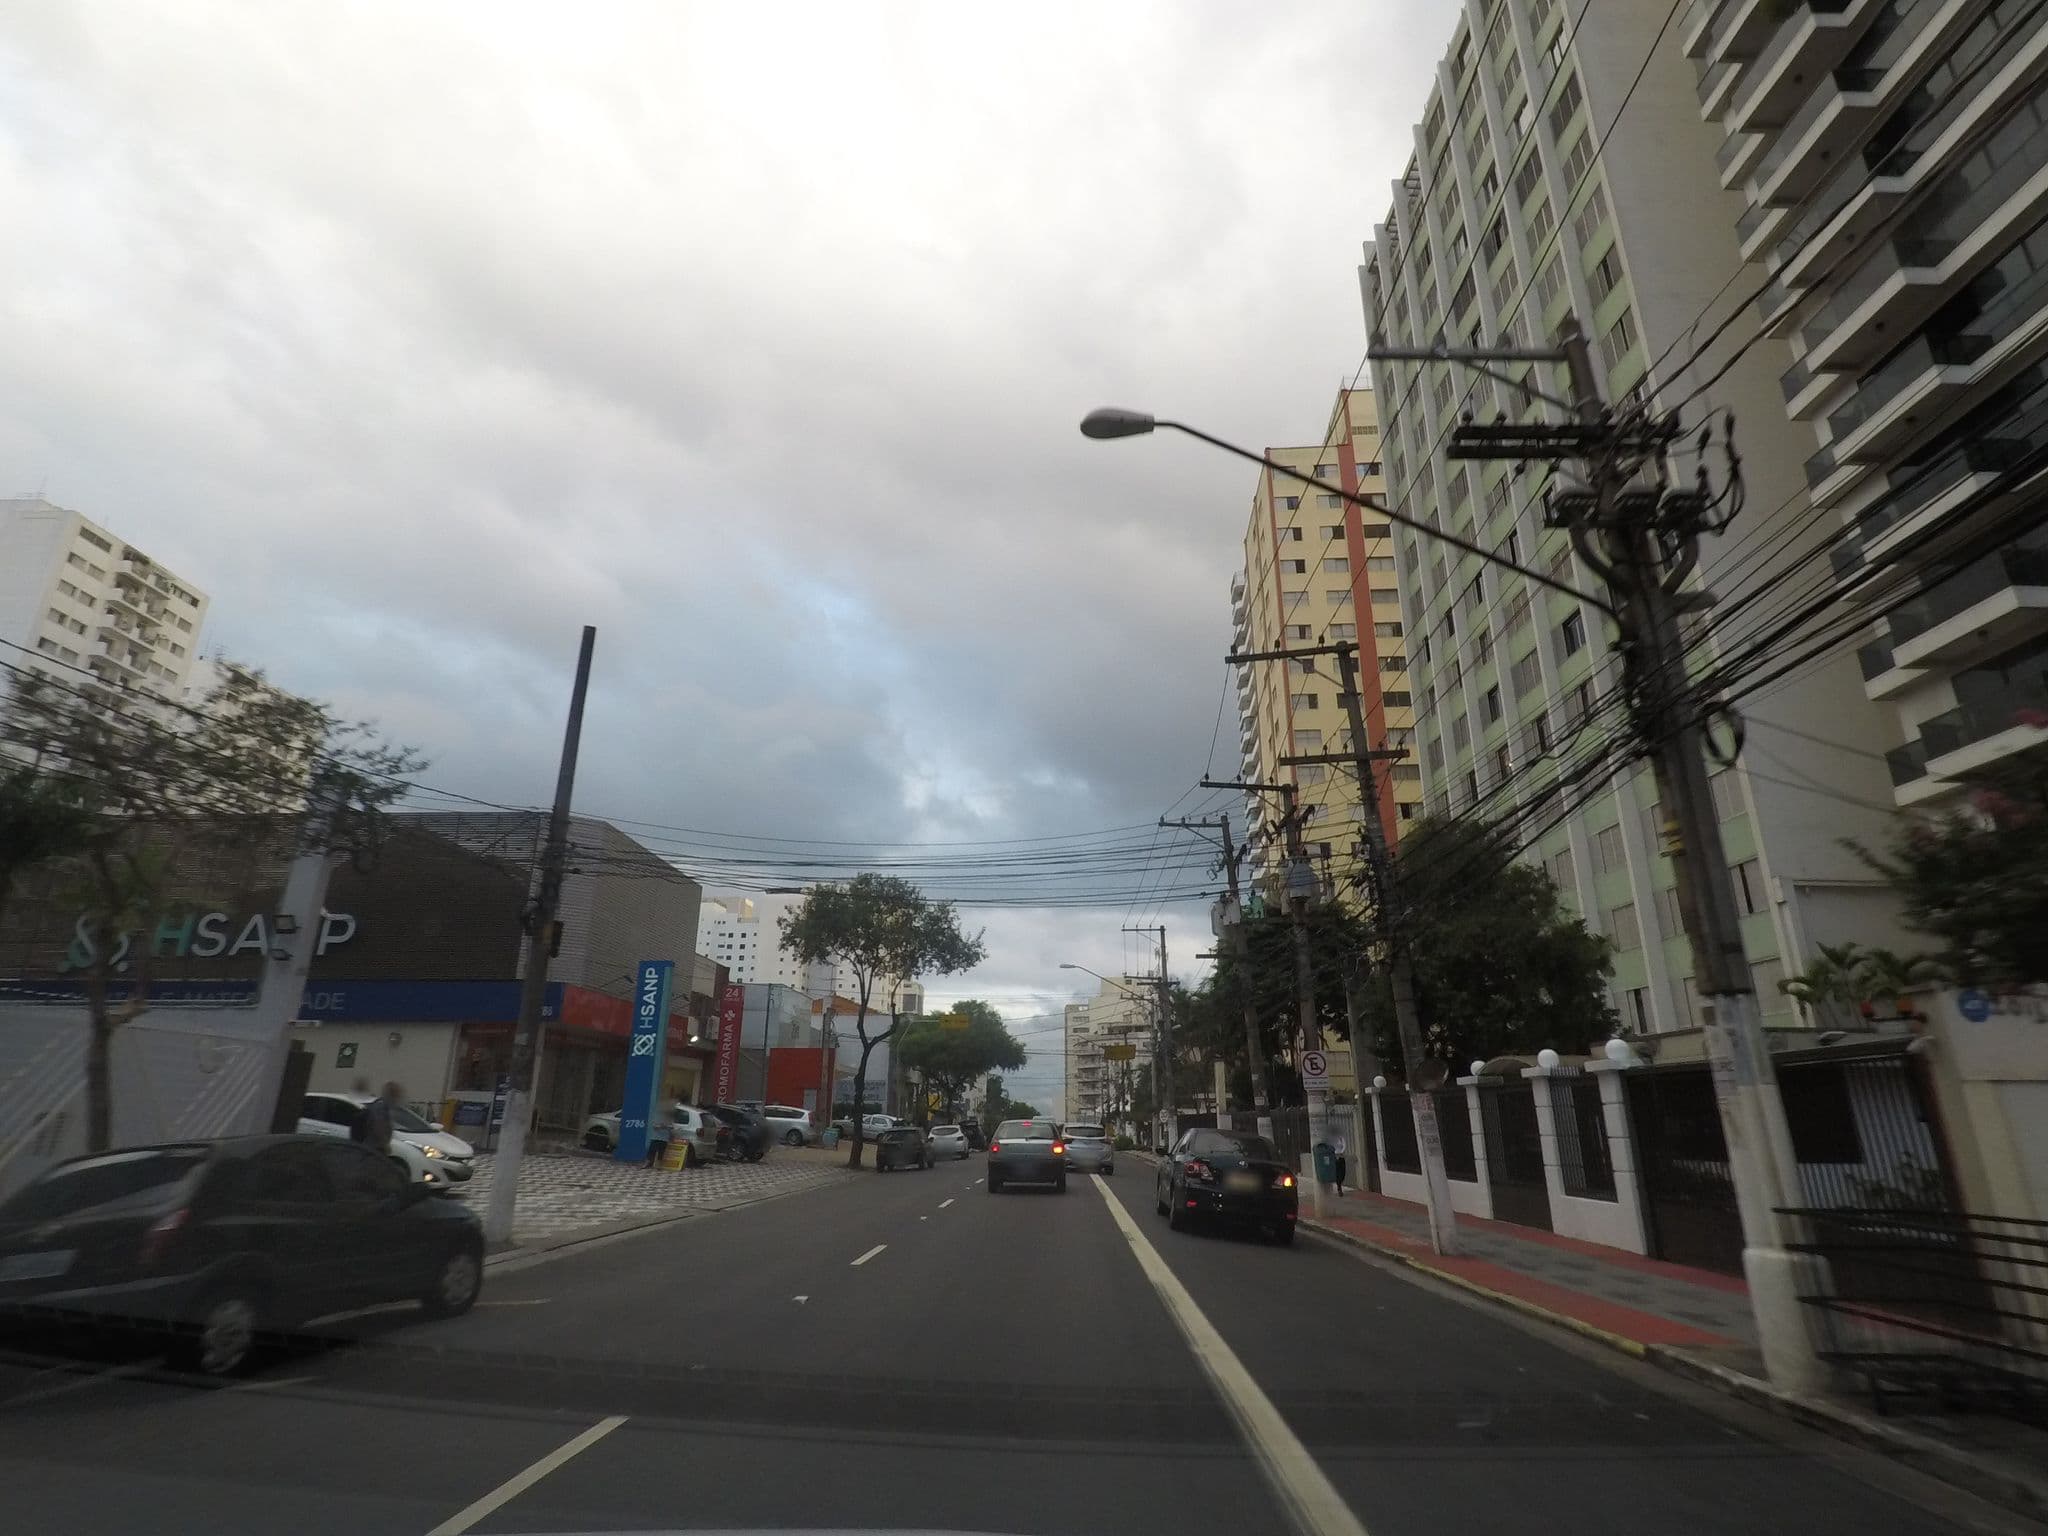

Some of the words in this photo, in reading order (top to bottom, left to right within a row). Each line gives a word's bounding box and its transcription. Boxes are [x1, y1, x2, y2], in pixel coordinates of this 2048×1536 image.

[153, 912, 357, 957] HSAP
[639, 968, 659, 1029] HSANP
[725, 988, 739, 998] 24
